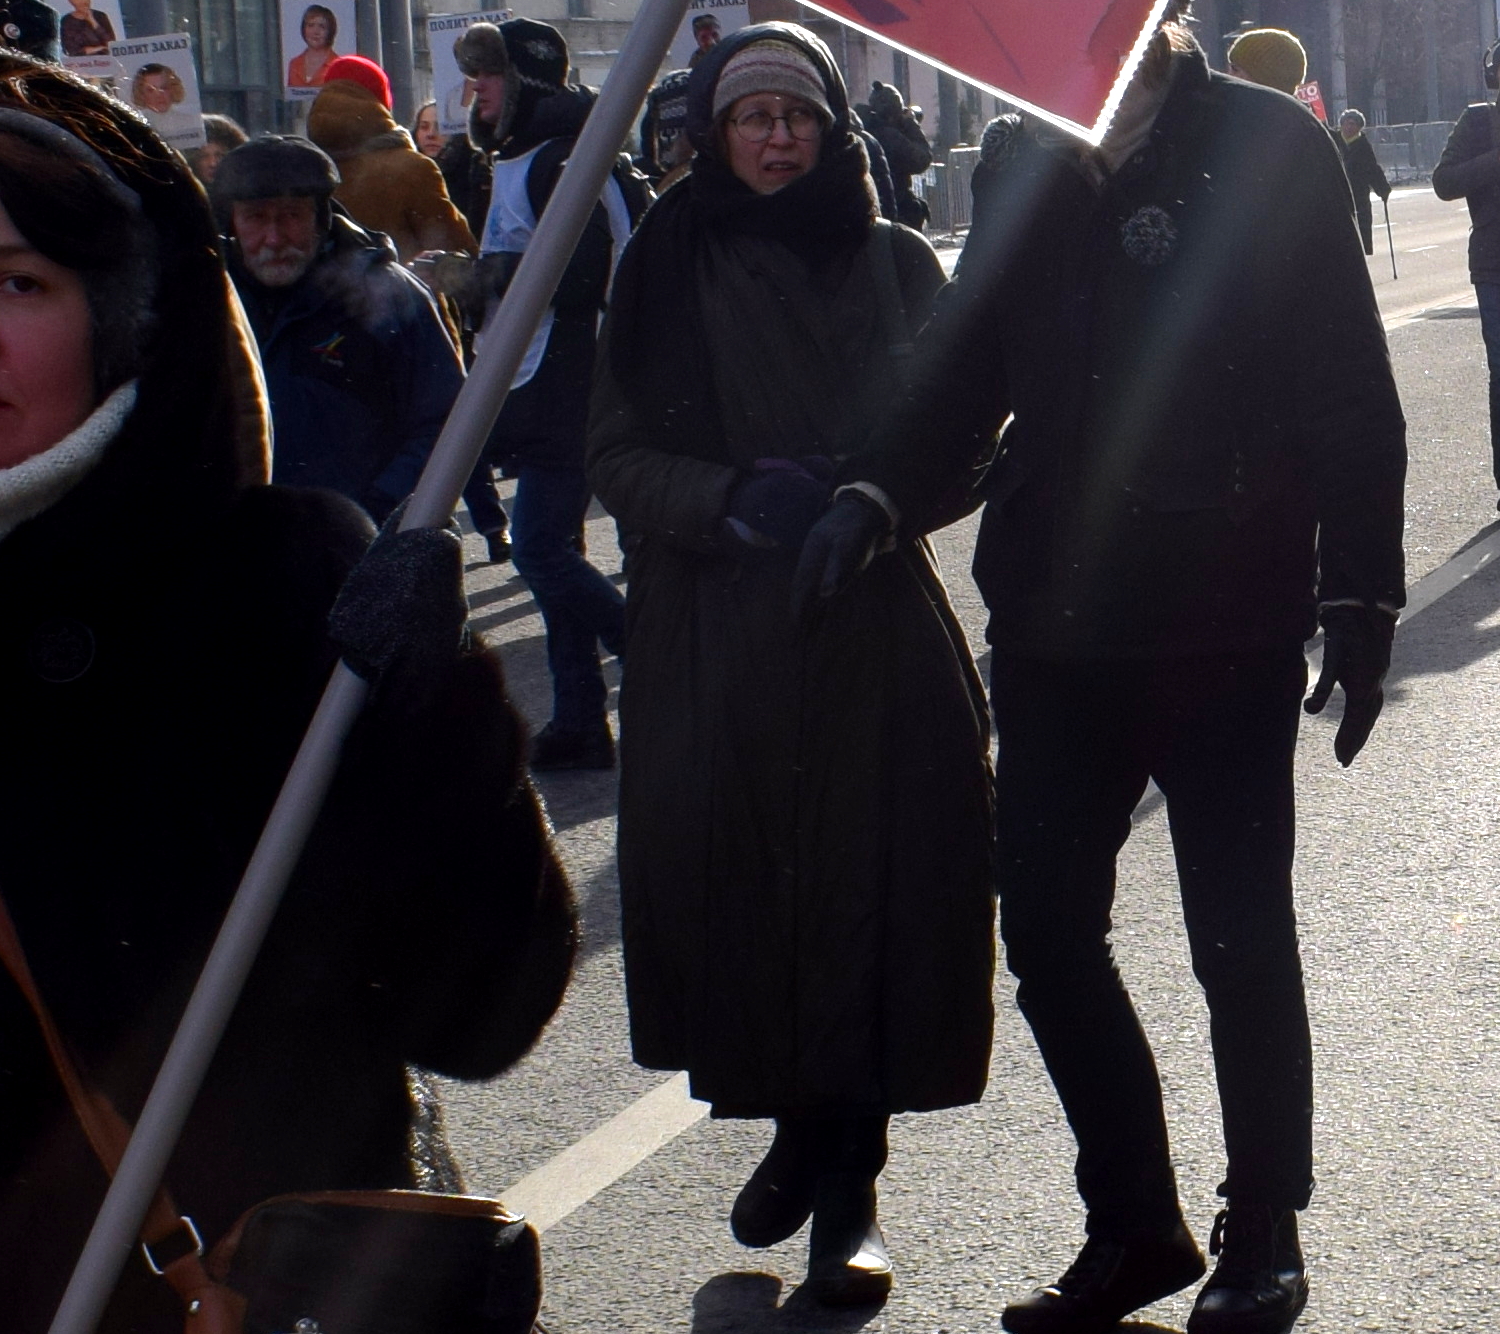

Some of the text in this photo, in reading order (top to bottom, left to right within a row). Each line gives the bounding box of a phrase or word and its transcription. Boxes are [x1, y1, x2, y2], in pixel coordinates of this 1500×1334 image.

[429, 18, 469, 32] ПОЛИТ
[112, 38, 188, 57] ПОЛИТ ЗАКАЗ
